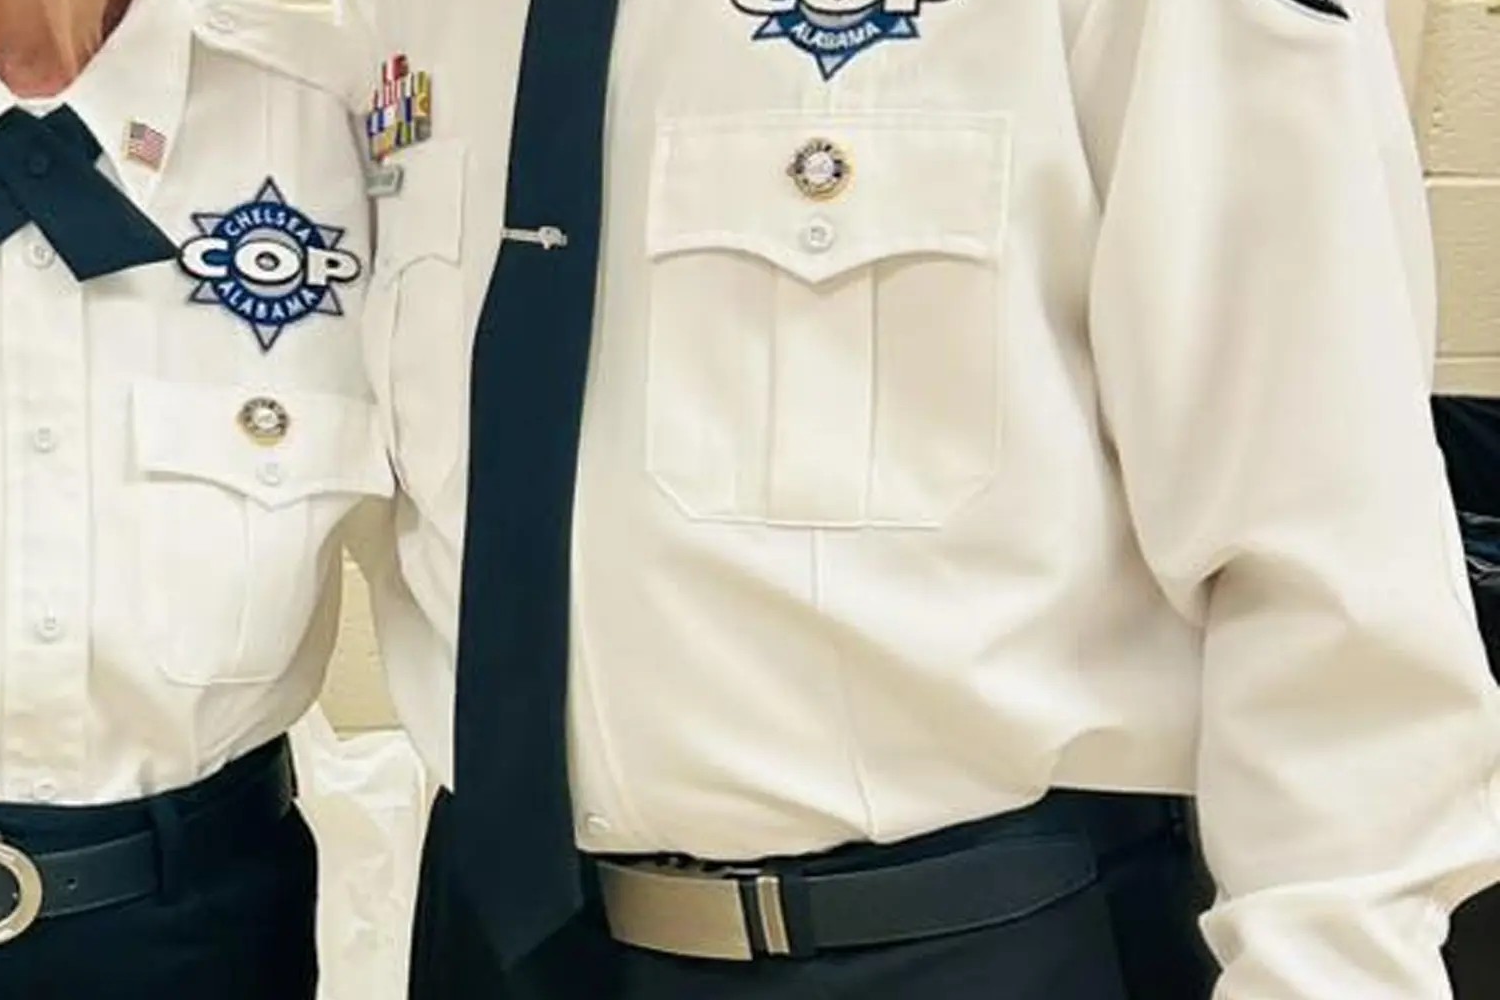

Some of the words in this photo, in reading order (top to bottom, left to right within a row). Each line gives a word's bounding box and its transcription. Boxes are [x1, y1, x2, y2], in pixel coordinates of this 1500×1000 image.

[791, 22, 882, 50] ALABAMA
[224, 209, 312, 245] CHELSEA
[180, 237, 361, 286] COP
[218, 281, 318, 319] ALABAMA
